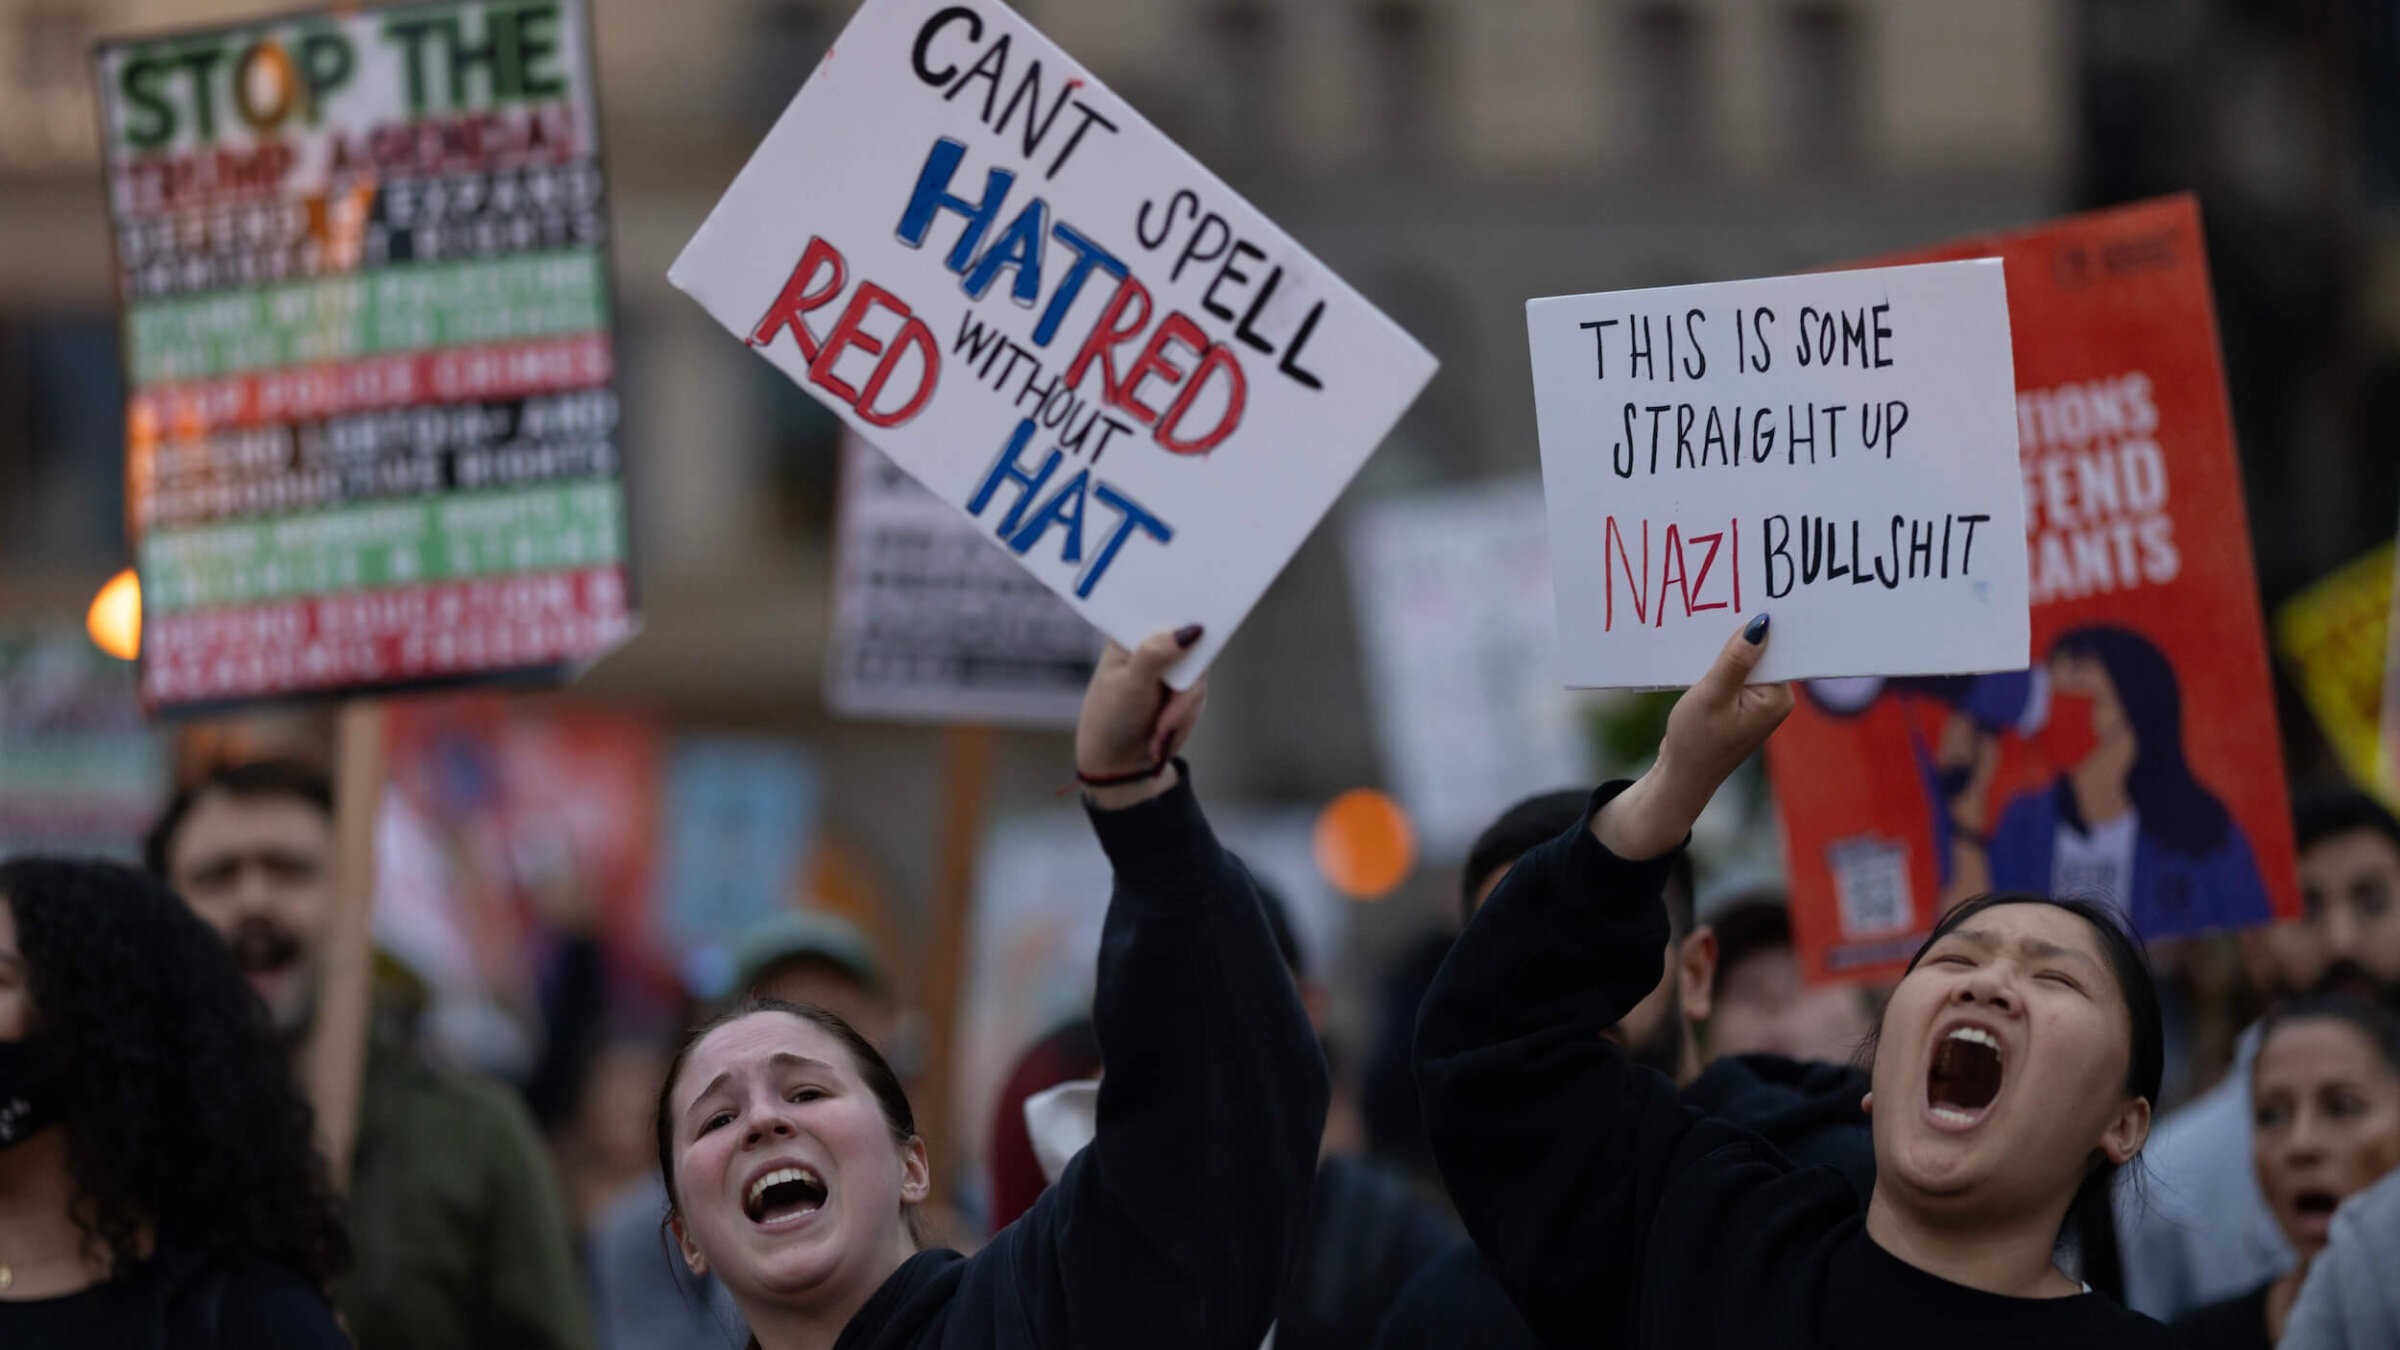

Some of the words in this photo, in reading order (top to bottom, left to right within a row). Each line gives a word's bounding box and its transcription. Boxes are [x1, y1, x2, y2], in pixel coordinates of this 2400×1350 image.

[120, 32, 355, 147] STOP
[383, 4, 567, 108] THE
[118, 142, 294, 212] TRUMP
[895, 136, 1249, 456] HATRED
[1136, 189, 1325, 391] SPELL
[1580, 309, 1706, 382] THIS
[1737, 307, 1775, 373] IS
[1797, 303, 1894, 370] SOME
[747, 235, 943, 428] RED
[965, 418, 1176, 600] HAT
[952, 310, 1134, 464] WITHOUT
[1613, 402, 1848, 479] STRAIGHT
[1862, 401, 1909, 459] UP
[1605, 516, 1741, 632] NAZI
[1763, 513, 1990, 599] BULLSHIT
